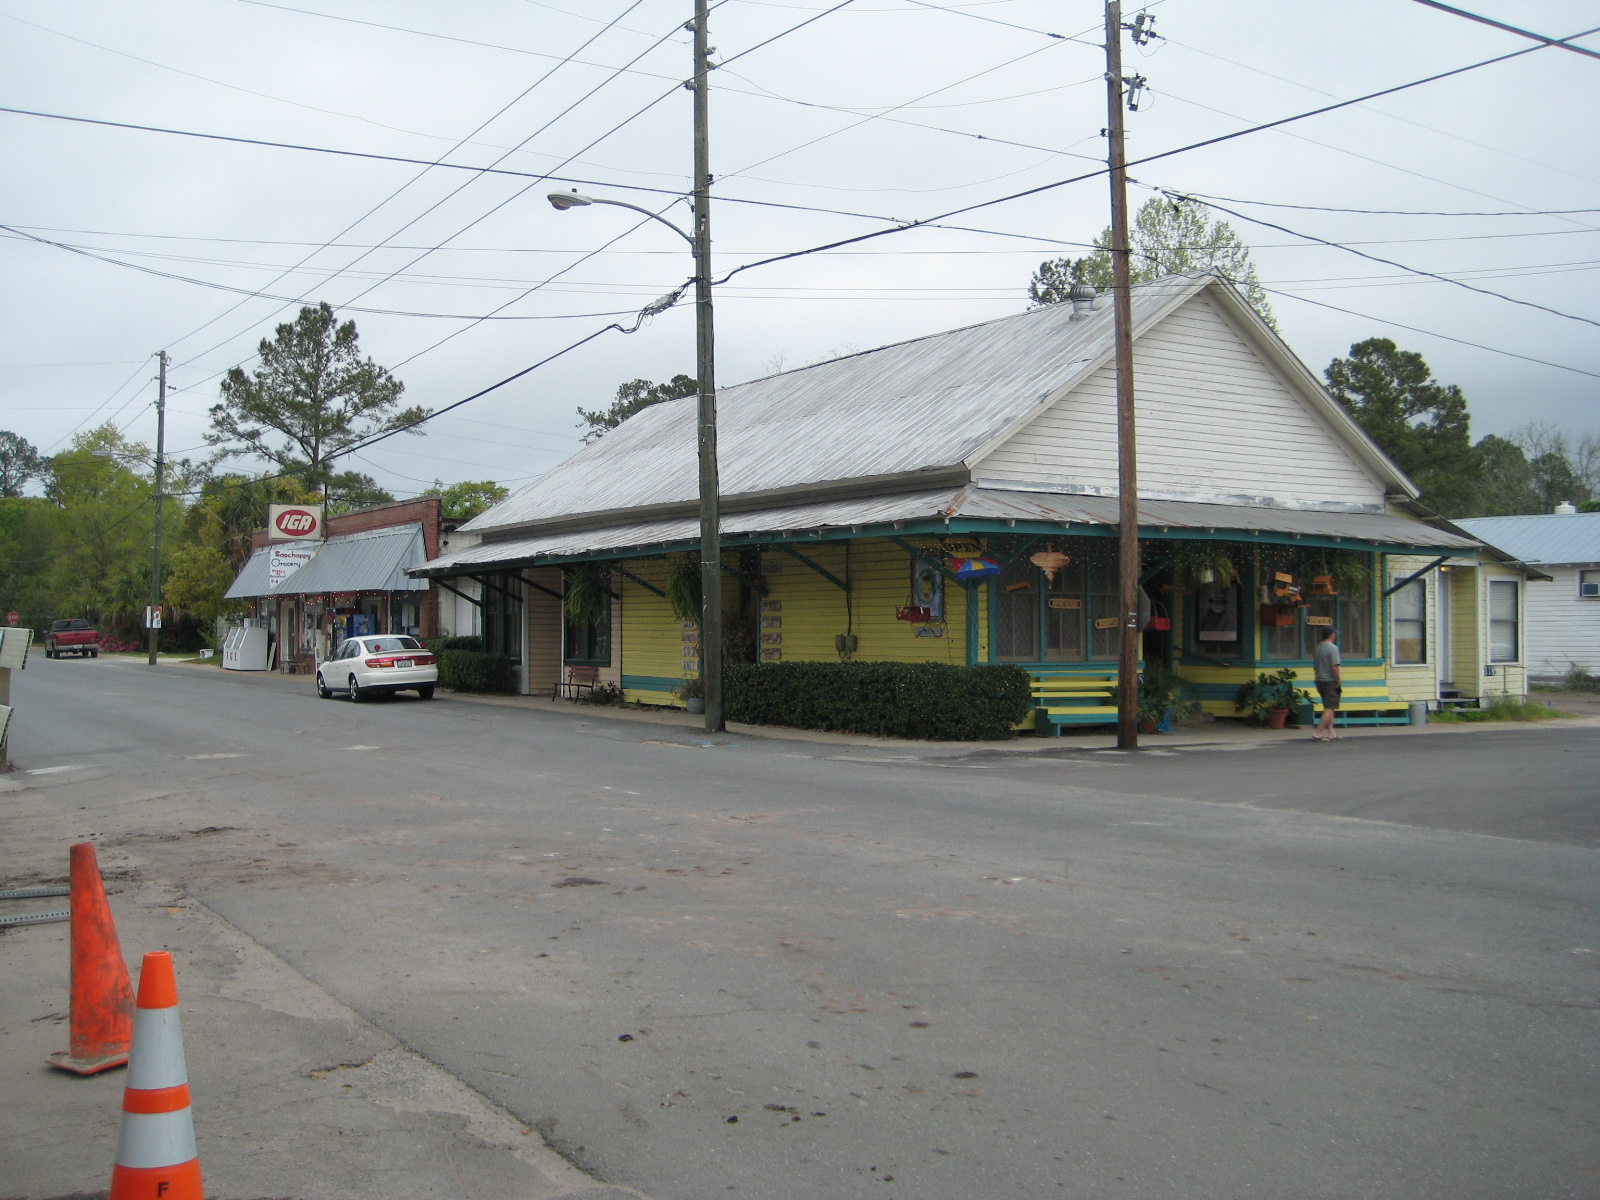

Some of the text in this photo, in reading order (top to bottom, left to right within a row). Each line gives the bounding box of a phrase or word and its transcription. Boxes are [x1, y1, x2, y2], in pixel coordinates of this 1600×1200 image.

[280, 514, 313, 531] IGA
[943, 542, 982, 553] OPEN
[158, 1181, 170, 1198] F
